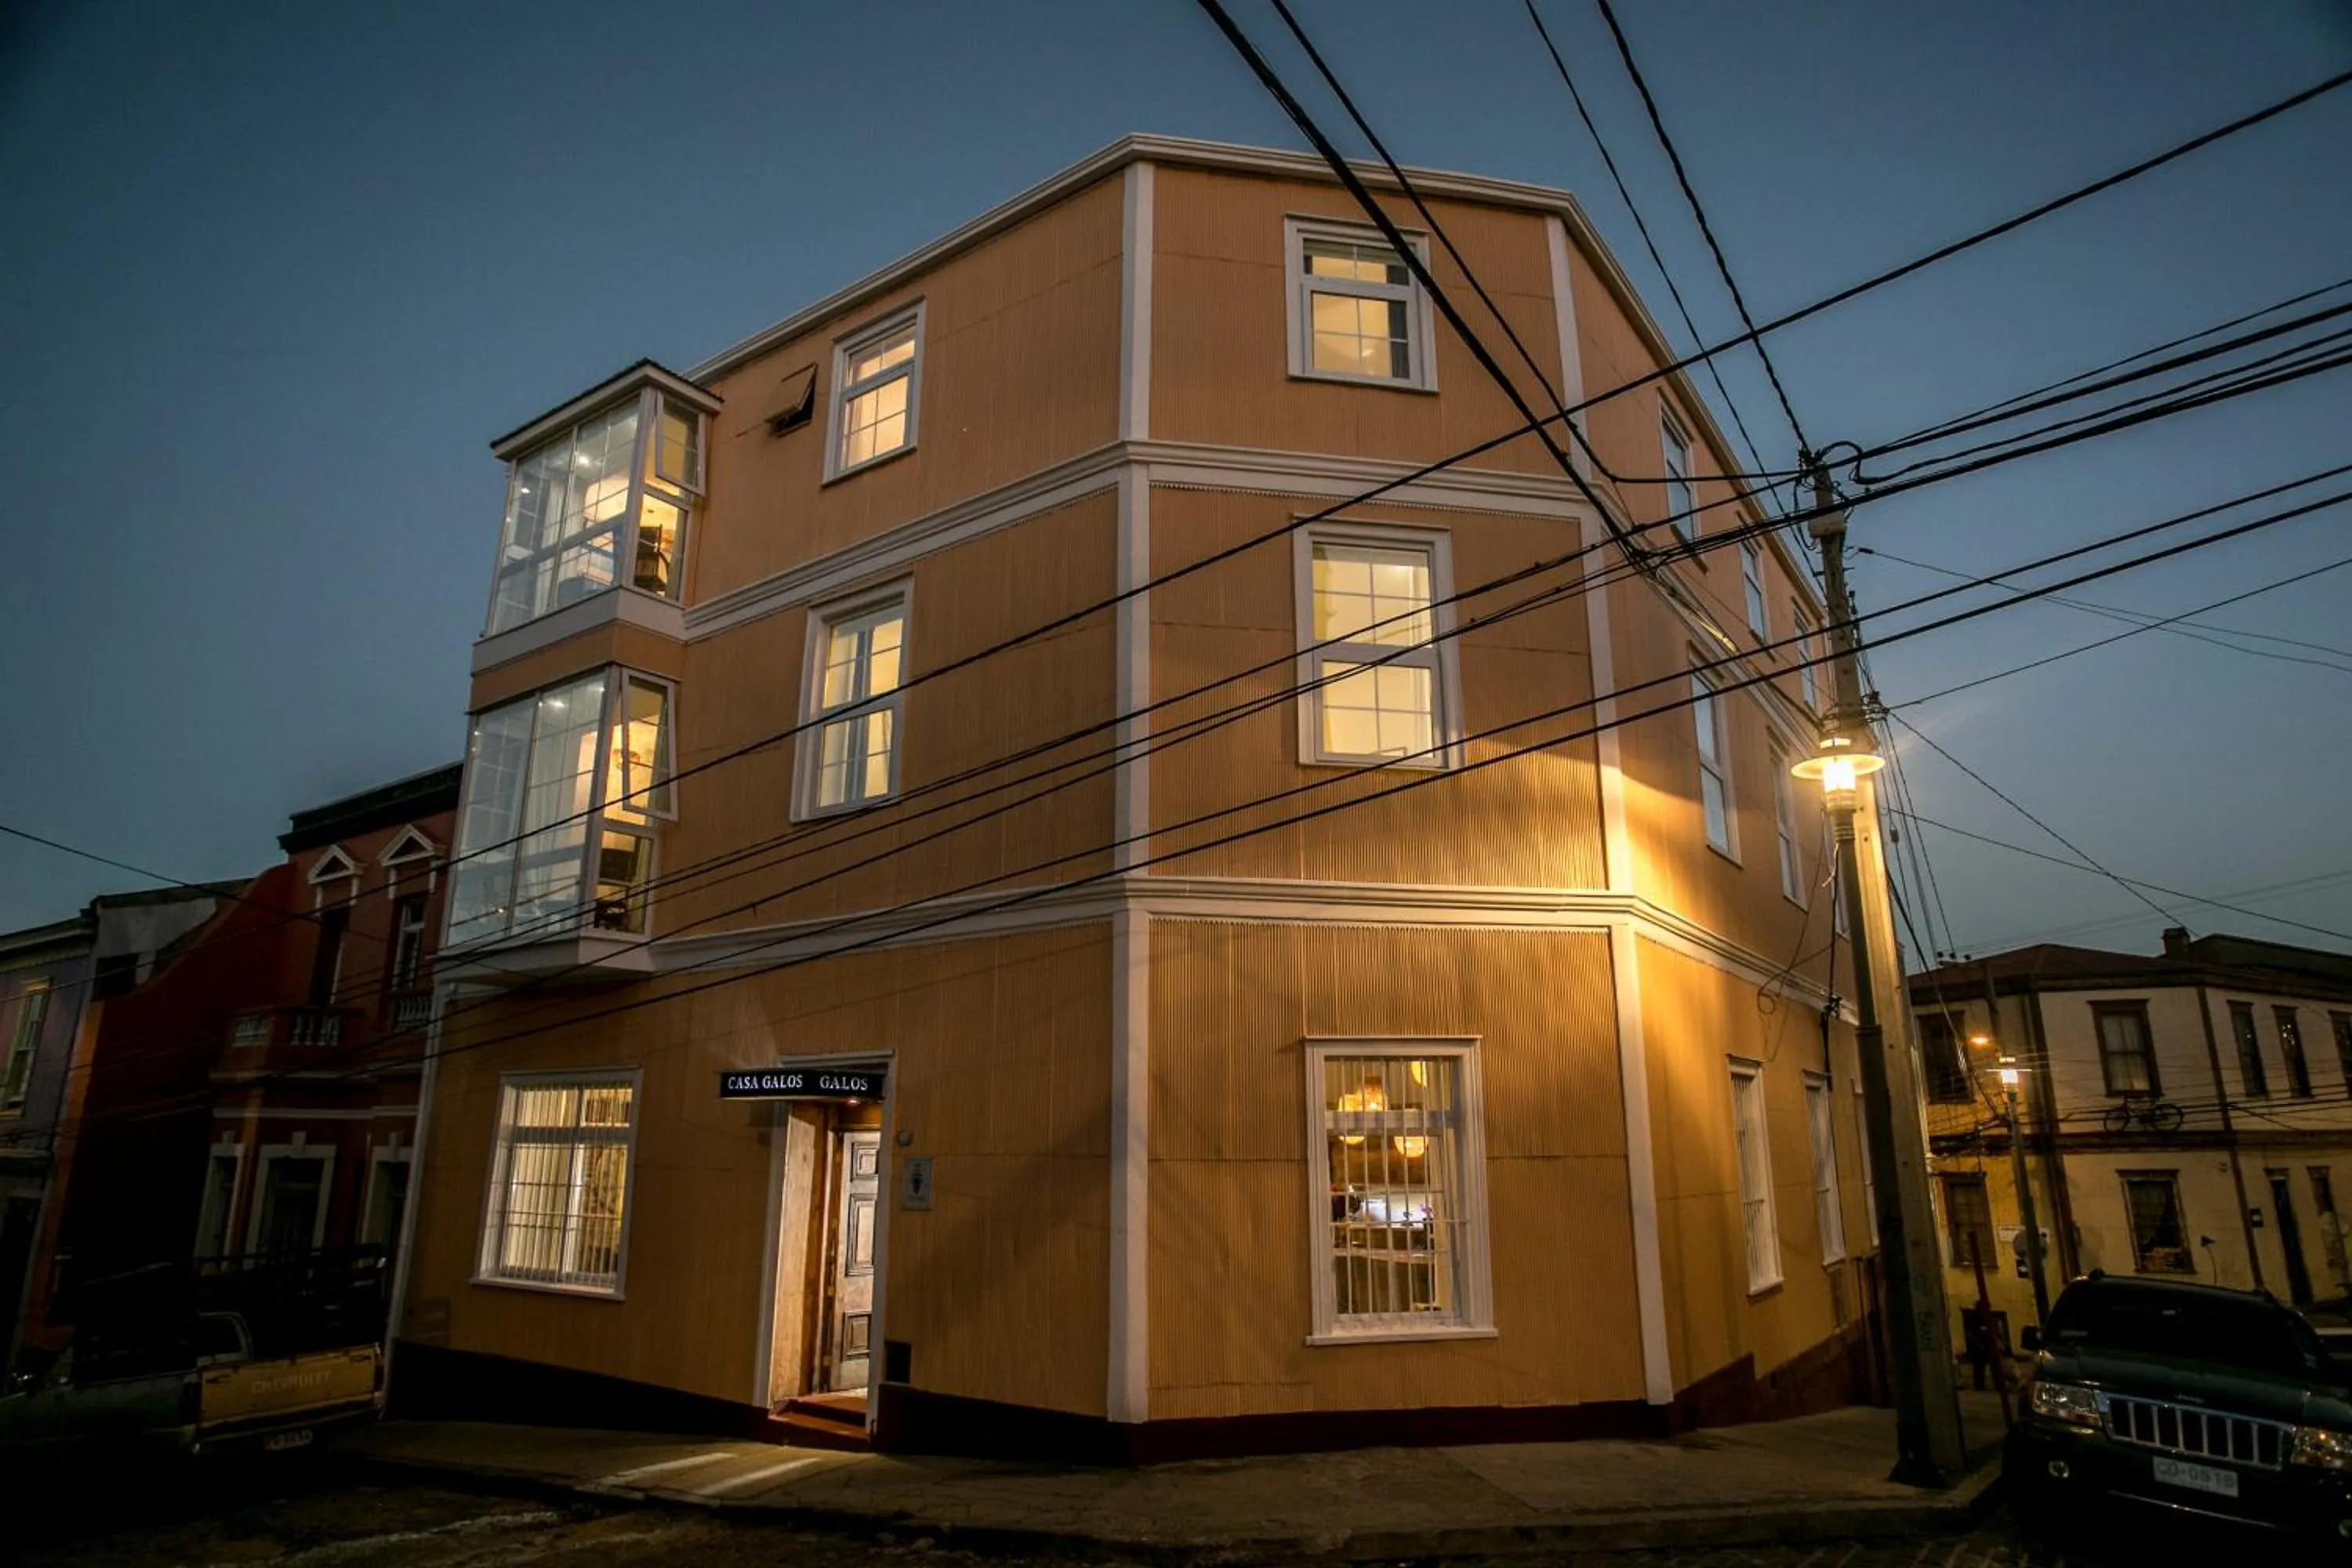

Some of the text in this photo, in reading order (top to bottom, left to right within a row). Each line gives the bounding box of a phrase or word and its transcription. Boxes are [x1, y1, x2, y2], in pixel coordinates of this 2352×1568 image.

[728, 1075, 804, 1090] CASA GALOS
[819, 1076, 869, 1091] GALOS
